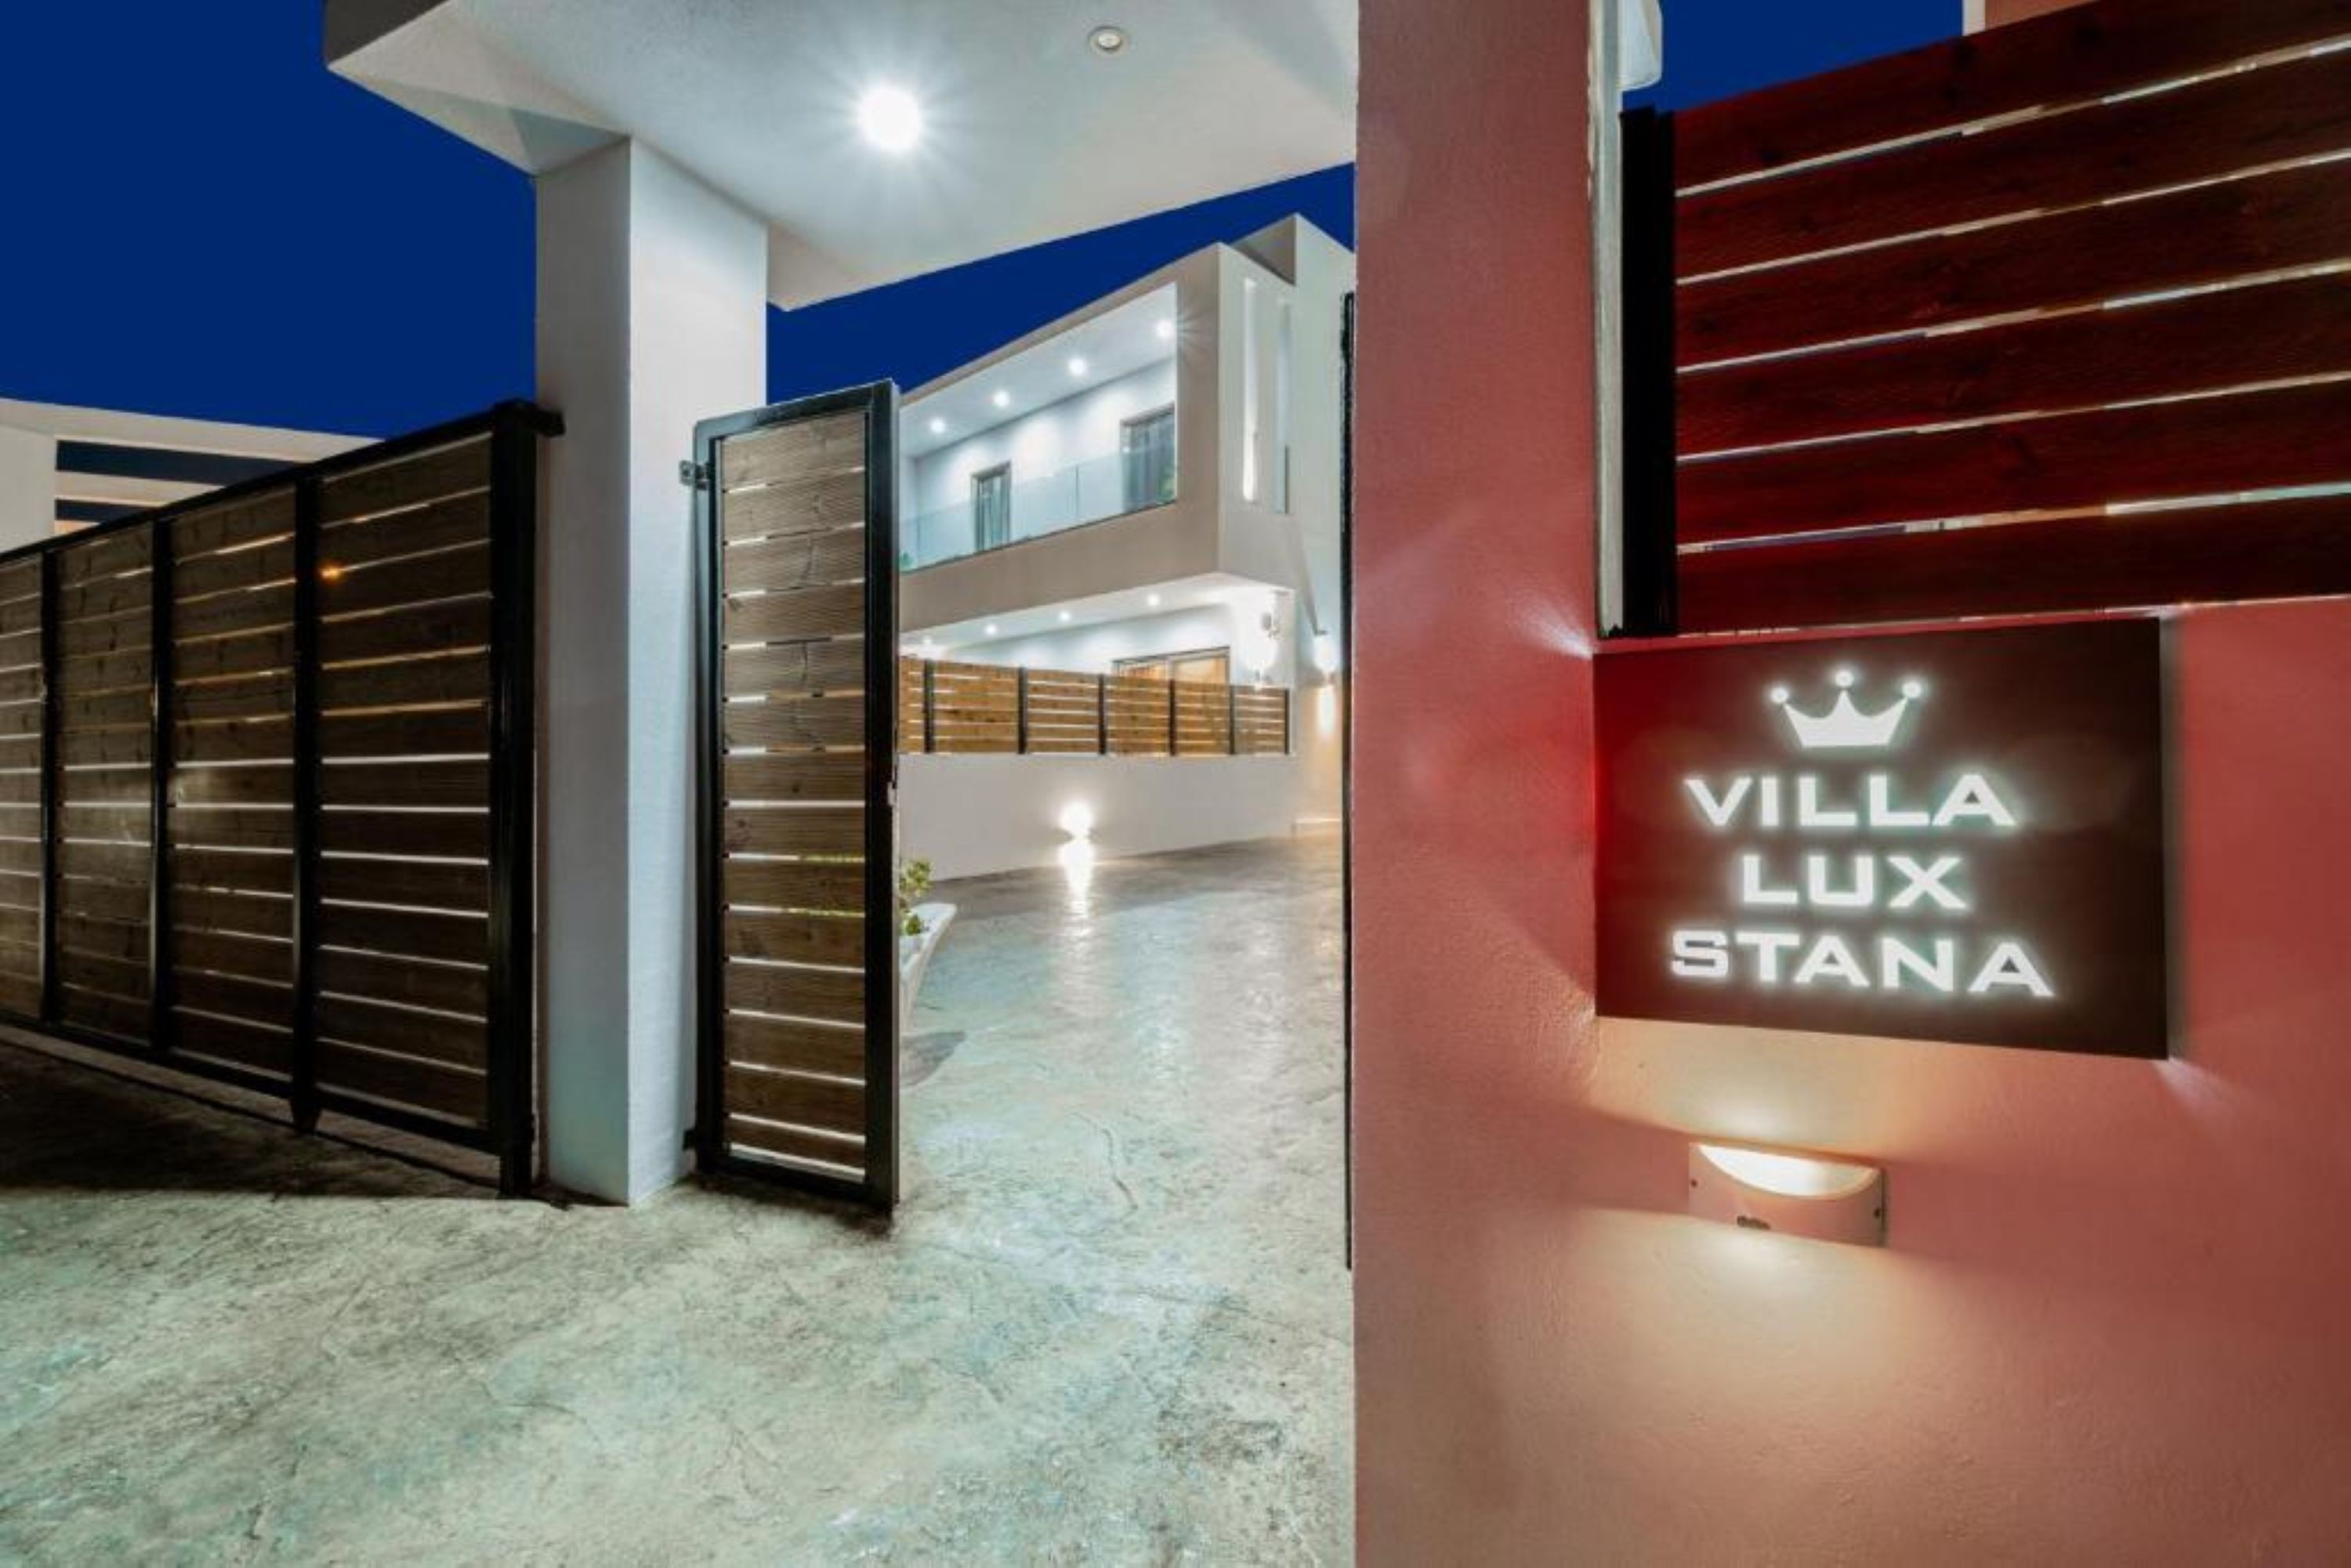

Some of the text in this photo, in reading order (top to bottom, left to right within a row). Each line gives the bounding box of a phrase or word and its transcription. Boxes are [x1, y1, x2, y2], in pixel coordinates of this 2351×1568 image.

[1685, 774, 2017, 827] VILLA
[1741, 855, 1968, 911] LUX
[1672, 930, 2053, 996] STANA
